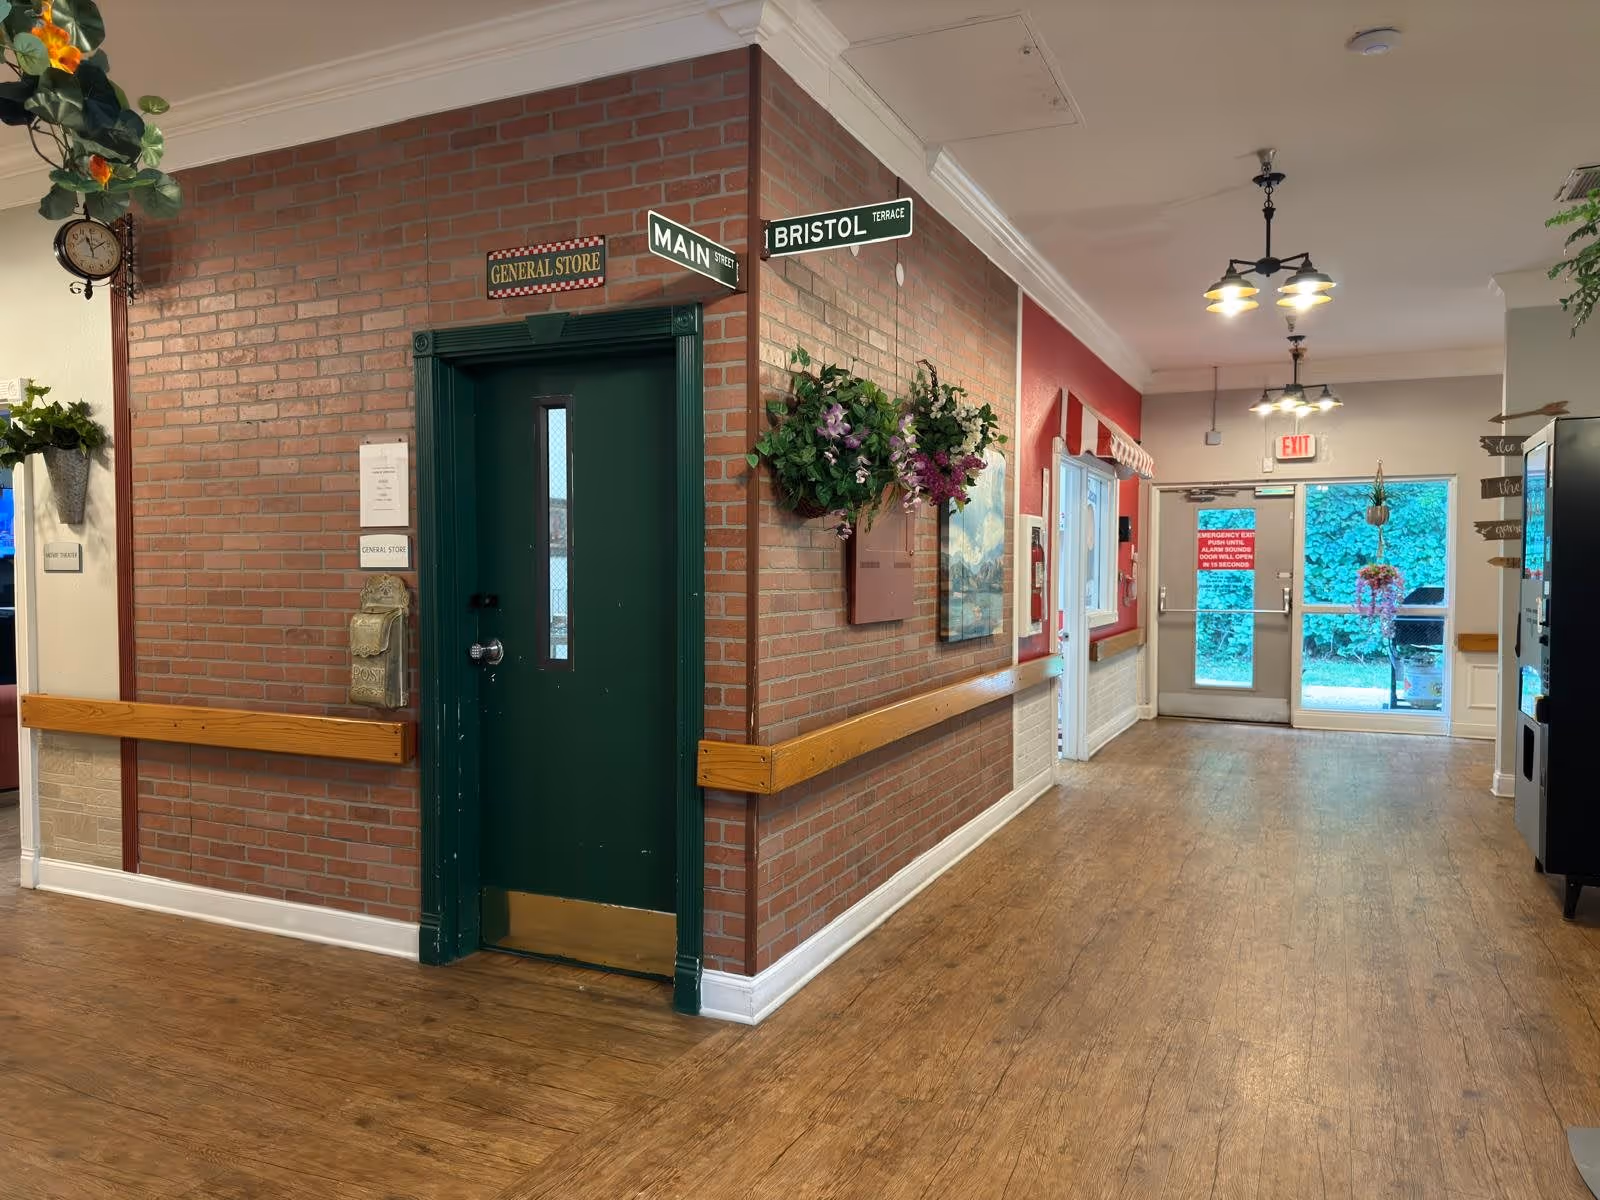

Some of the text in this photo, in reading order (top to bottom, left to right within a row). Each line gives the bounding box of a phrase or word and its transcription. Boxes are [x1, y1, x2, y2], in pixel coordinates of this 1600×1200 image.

[774, 207, 905, 248] BRISTOL TERRACE
[654, 222, 735, 269] MAIN STREET
[491, 252, 601, 285] GENERAL STORE
[1282, 435, 1310, 457] EXIT
[362, 545, 407, 554] GENERAL STORE
[351, 664, 385, 688] POST
